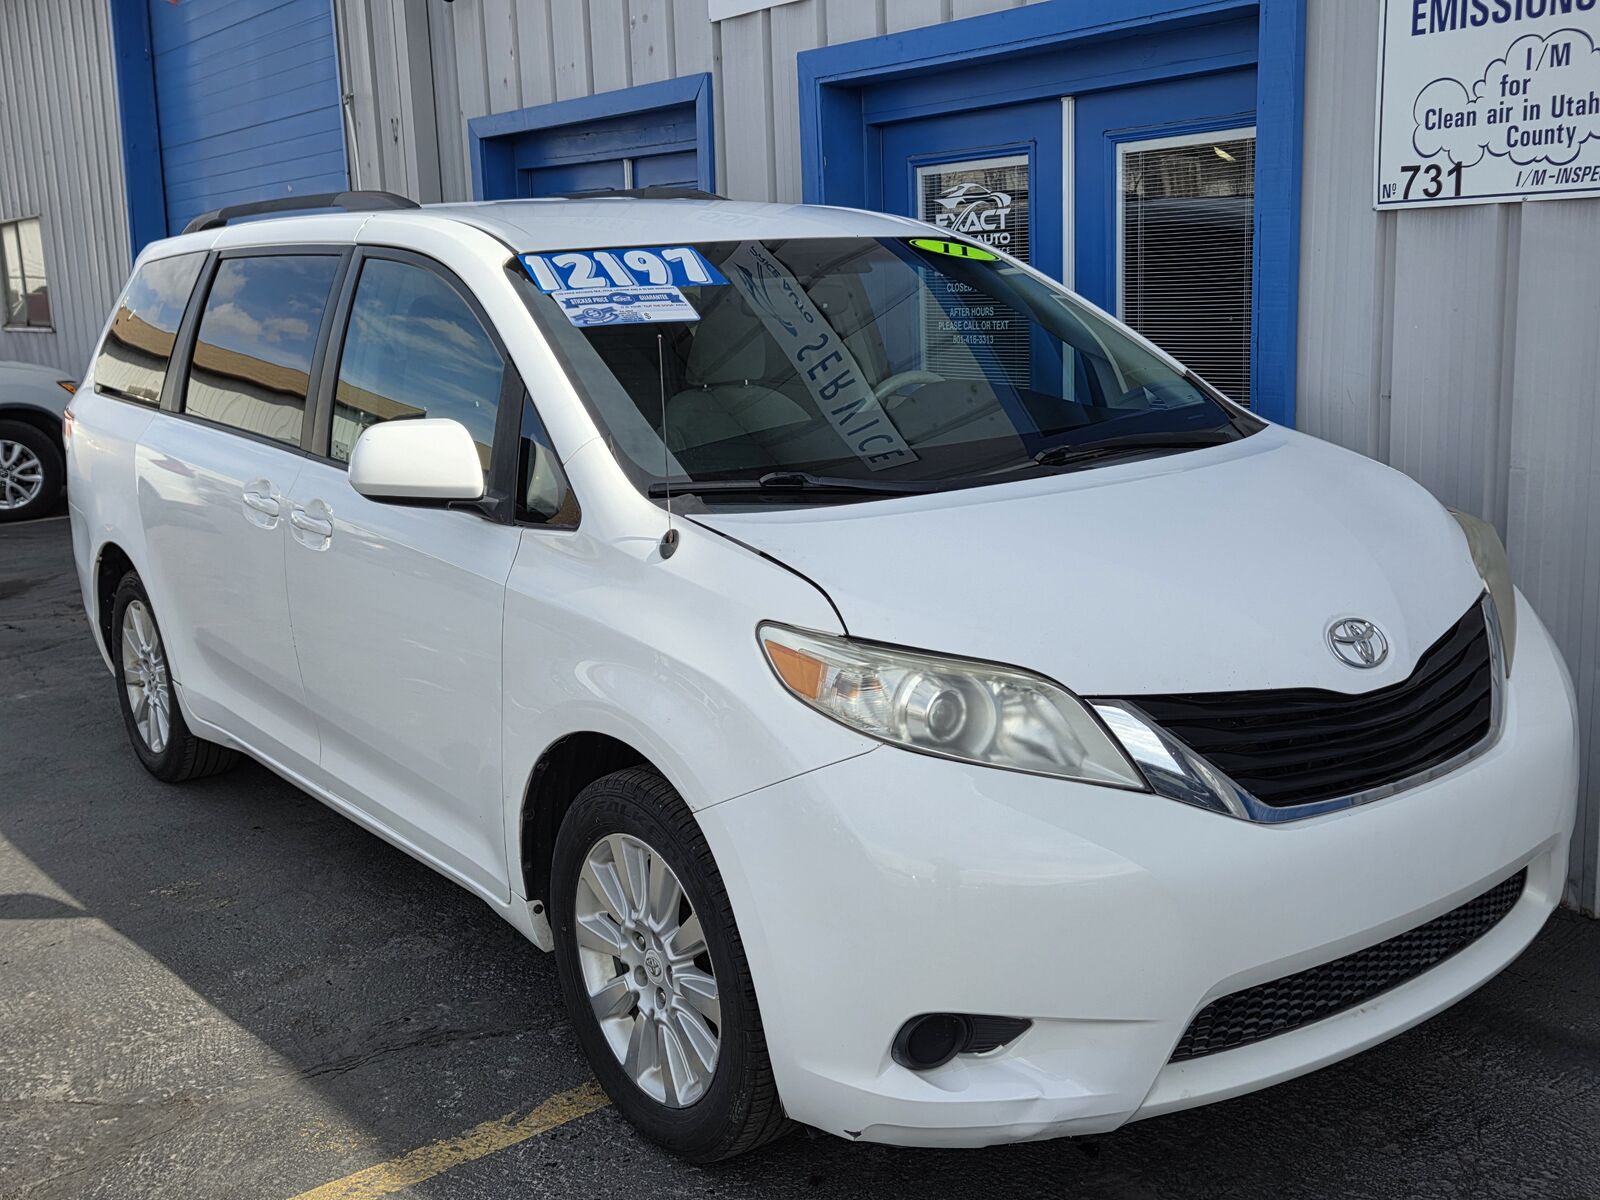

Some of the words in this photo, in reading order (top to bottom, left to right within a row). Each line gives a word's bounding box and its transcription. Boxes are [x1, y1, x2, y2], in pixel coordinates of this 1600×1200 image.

[1411, 0, 1598, 36] EMISSI
[1526, 42, 1571, 72] I/M
[1500, 74, 1531, 97] for
[1424, 107, 1477, 130] Clean
[1487, 101, 1513, 125] air
[1522, 98, 1541, 121] in
[1551, 91, 1600, 119] Utah
[1506, 124, 1577, 148] County
[1400, 161, 1463, 200] 731
[1515, 165, 1600, 188] I/M-INSPE
[936, 207, 1011, 233] EXACT
[977, 232, 1011, 245] AUTO
[524, 248, 713, 290] 12197
[570, 296, 592, 305] STICKER
[593, 296, 609, 304] PRICE
[949, 307, 970, 318] AFTER
[971, 306, 994, 317] HOURS
[938, 321, 962, 331] PLEASE
[963, 321, 981, 331] CALL
[981, 321, 991, 330] OR
[992, 320, 1010, 330] TEXT
